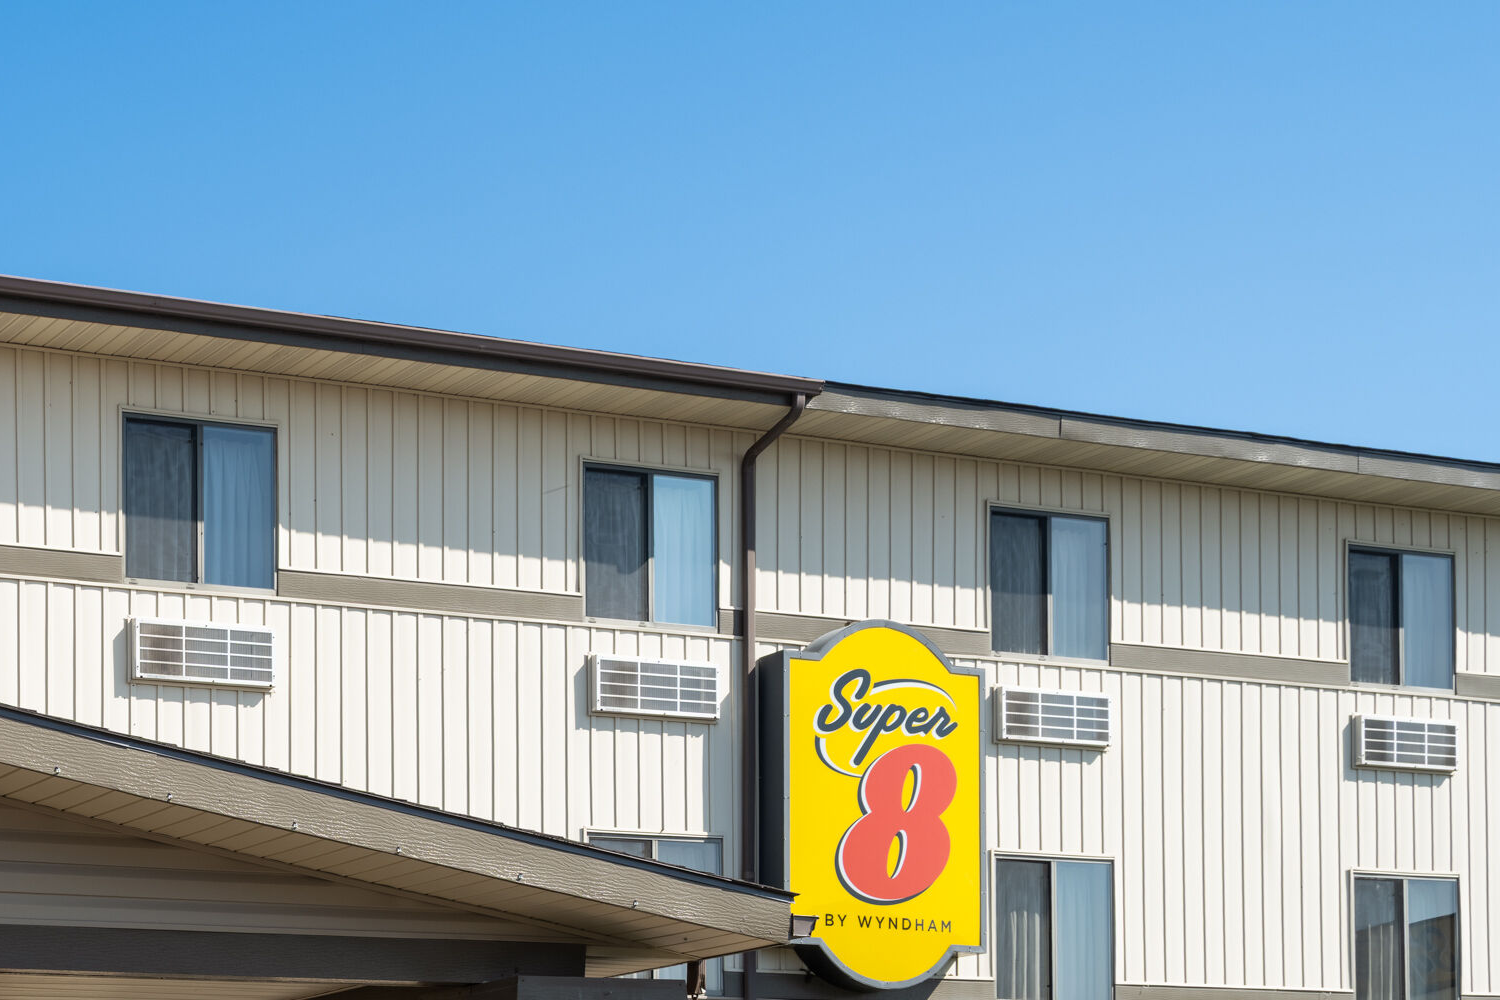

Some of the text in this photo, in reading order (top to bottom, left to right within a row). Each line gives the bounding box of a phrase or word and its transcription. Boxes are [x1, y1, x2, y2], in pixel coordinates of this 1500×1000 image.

[813, 668, 958, 768] Super
[834, 743, 958, 906] 8
[824, 913, 952, 933] BY WYNDHAM
